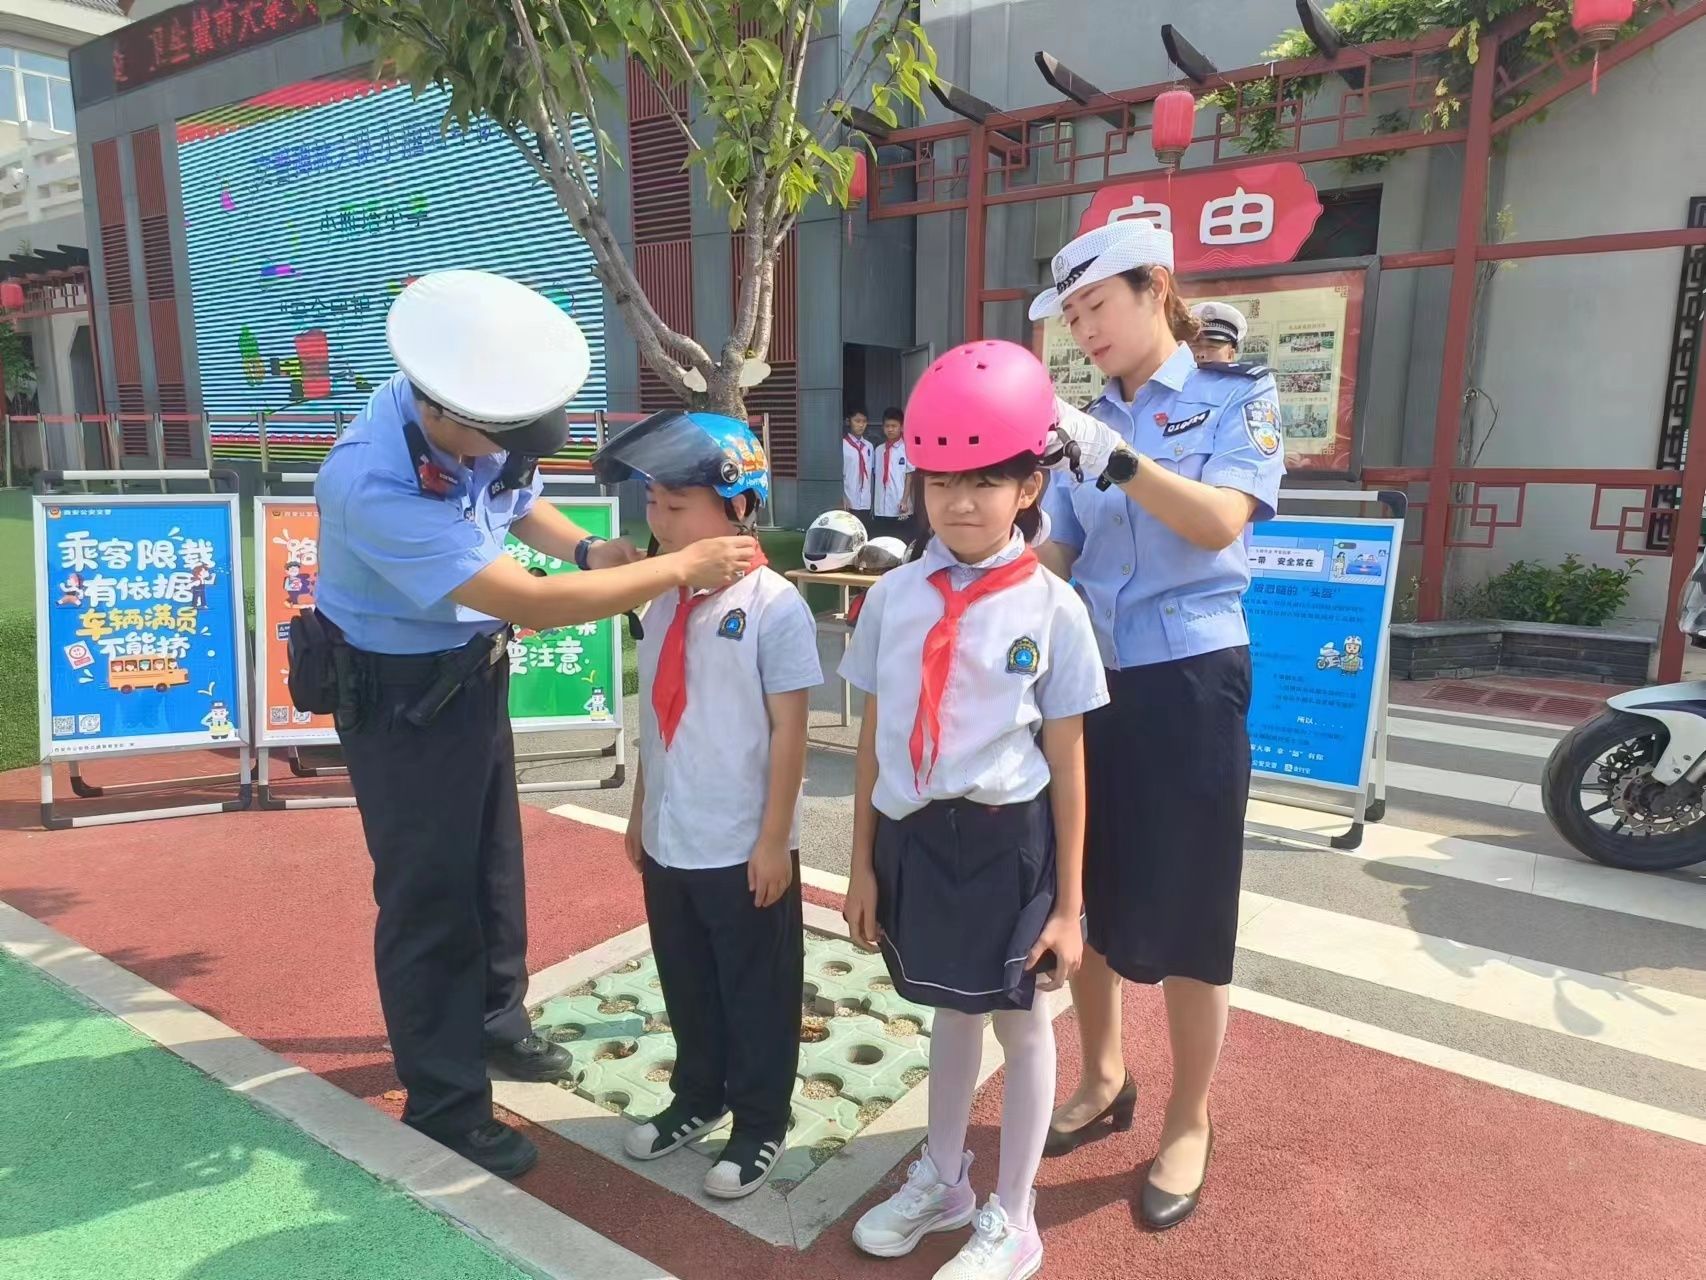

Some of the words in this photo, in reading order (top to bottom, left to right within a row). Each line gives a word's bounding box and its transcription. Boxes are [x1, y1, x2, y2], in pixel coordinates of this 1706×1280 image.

[59, 531, 215, 571] 乘客限载
[84, 573, 194, 607] 有依据
[76, 604, 197, 640] 车辆满员
[99, 632, 190, 658] 不能挤
[507, 635, 584, 675] 要注意
